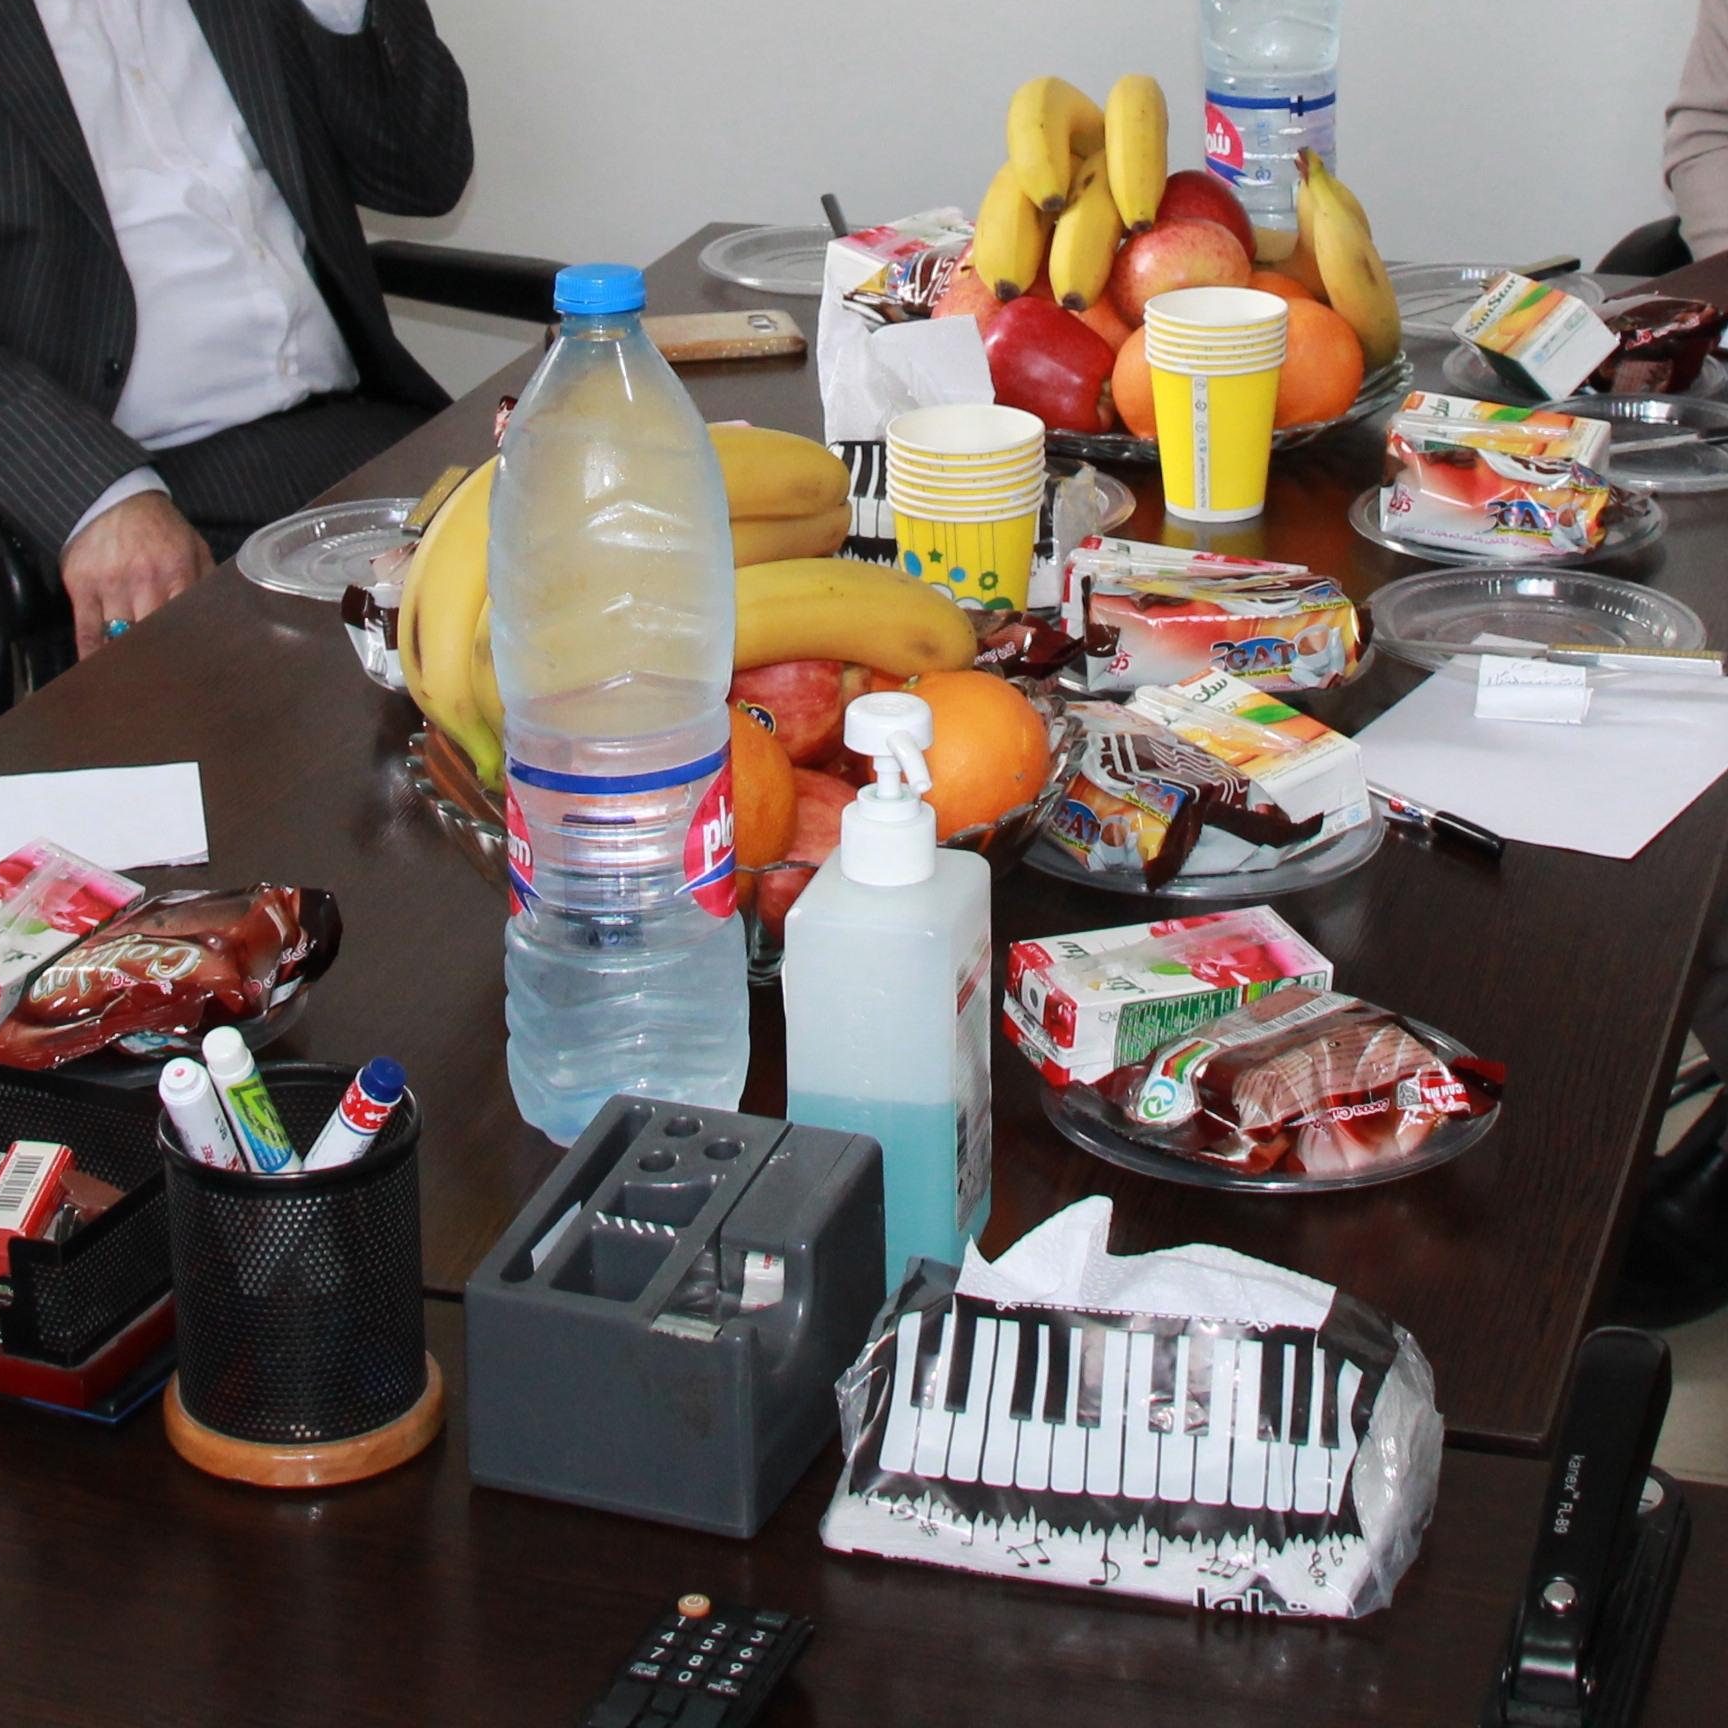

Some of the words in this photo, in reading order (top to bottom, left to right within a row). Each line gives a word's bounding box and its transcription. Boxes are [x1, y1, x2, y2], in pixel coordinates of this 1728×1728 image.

[676, 1615, 687, 1626] 1
[712, 1622, 726, 1634] 2
[661, 1631, 674, 1643] 4
[750, 1630, 766, 1642] 3
[700, 1638, 715, 1650] 5
[650, 1646, 665, 1659] 7
[739, 1647, 753, 1659] 6
[688, 1654, 703, 1666] 8
[729, 1662, 744, 1674] 9
[678, 1671, 692, 1682] 0
